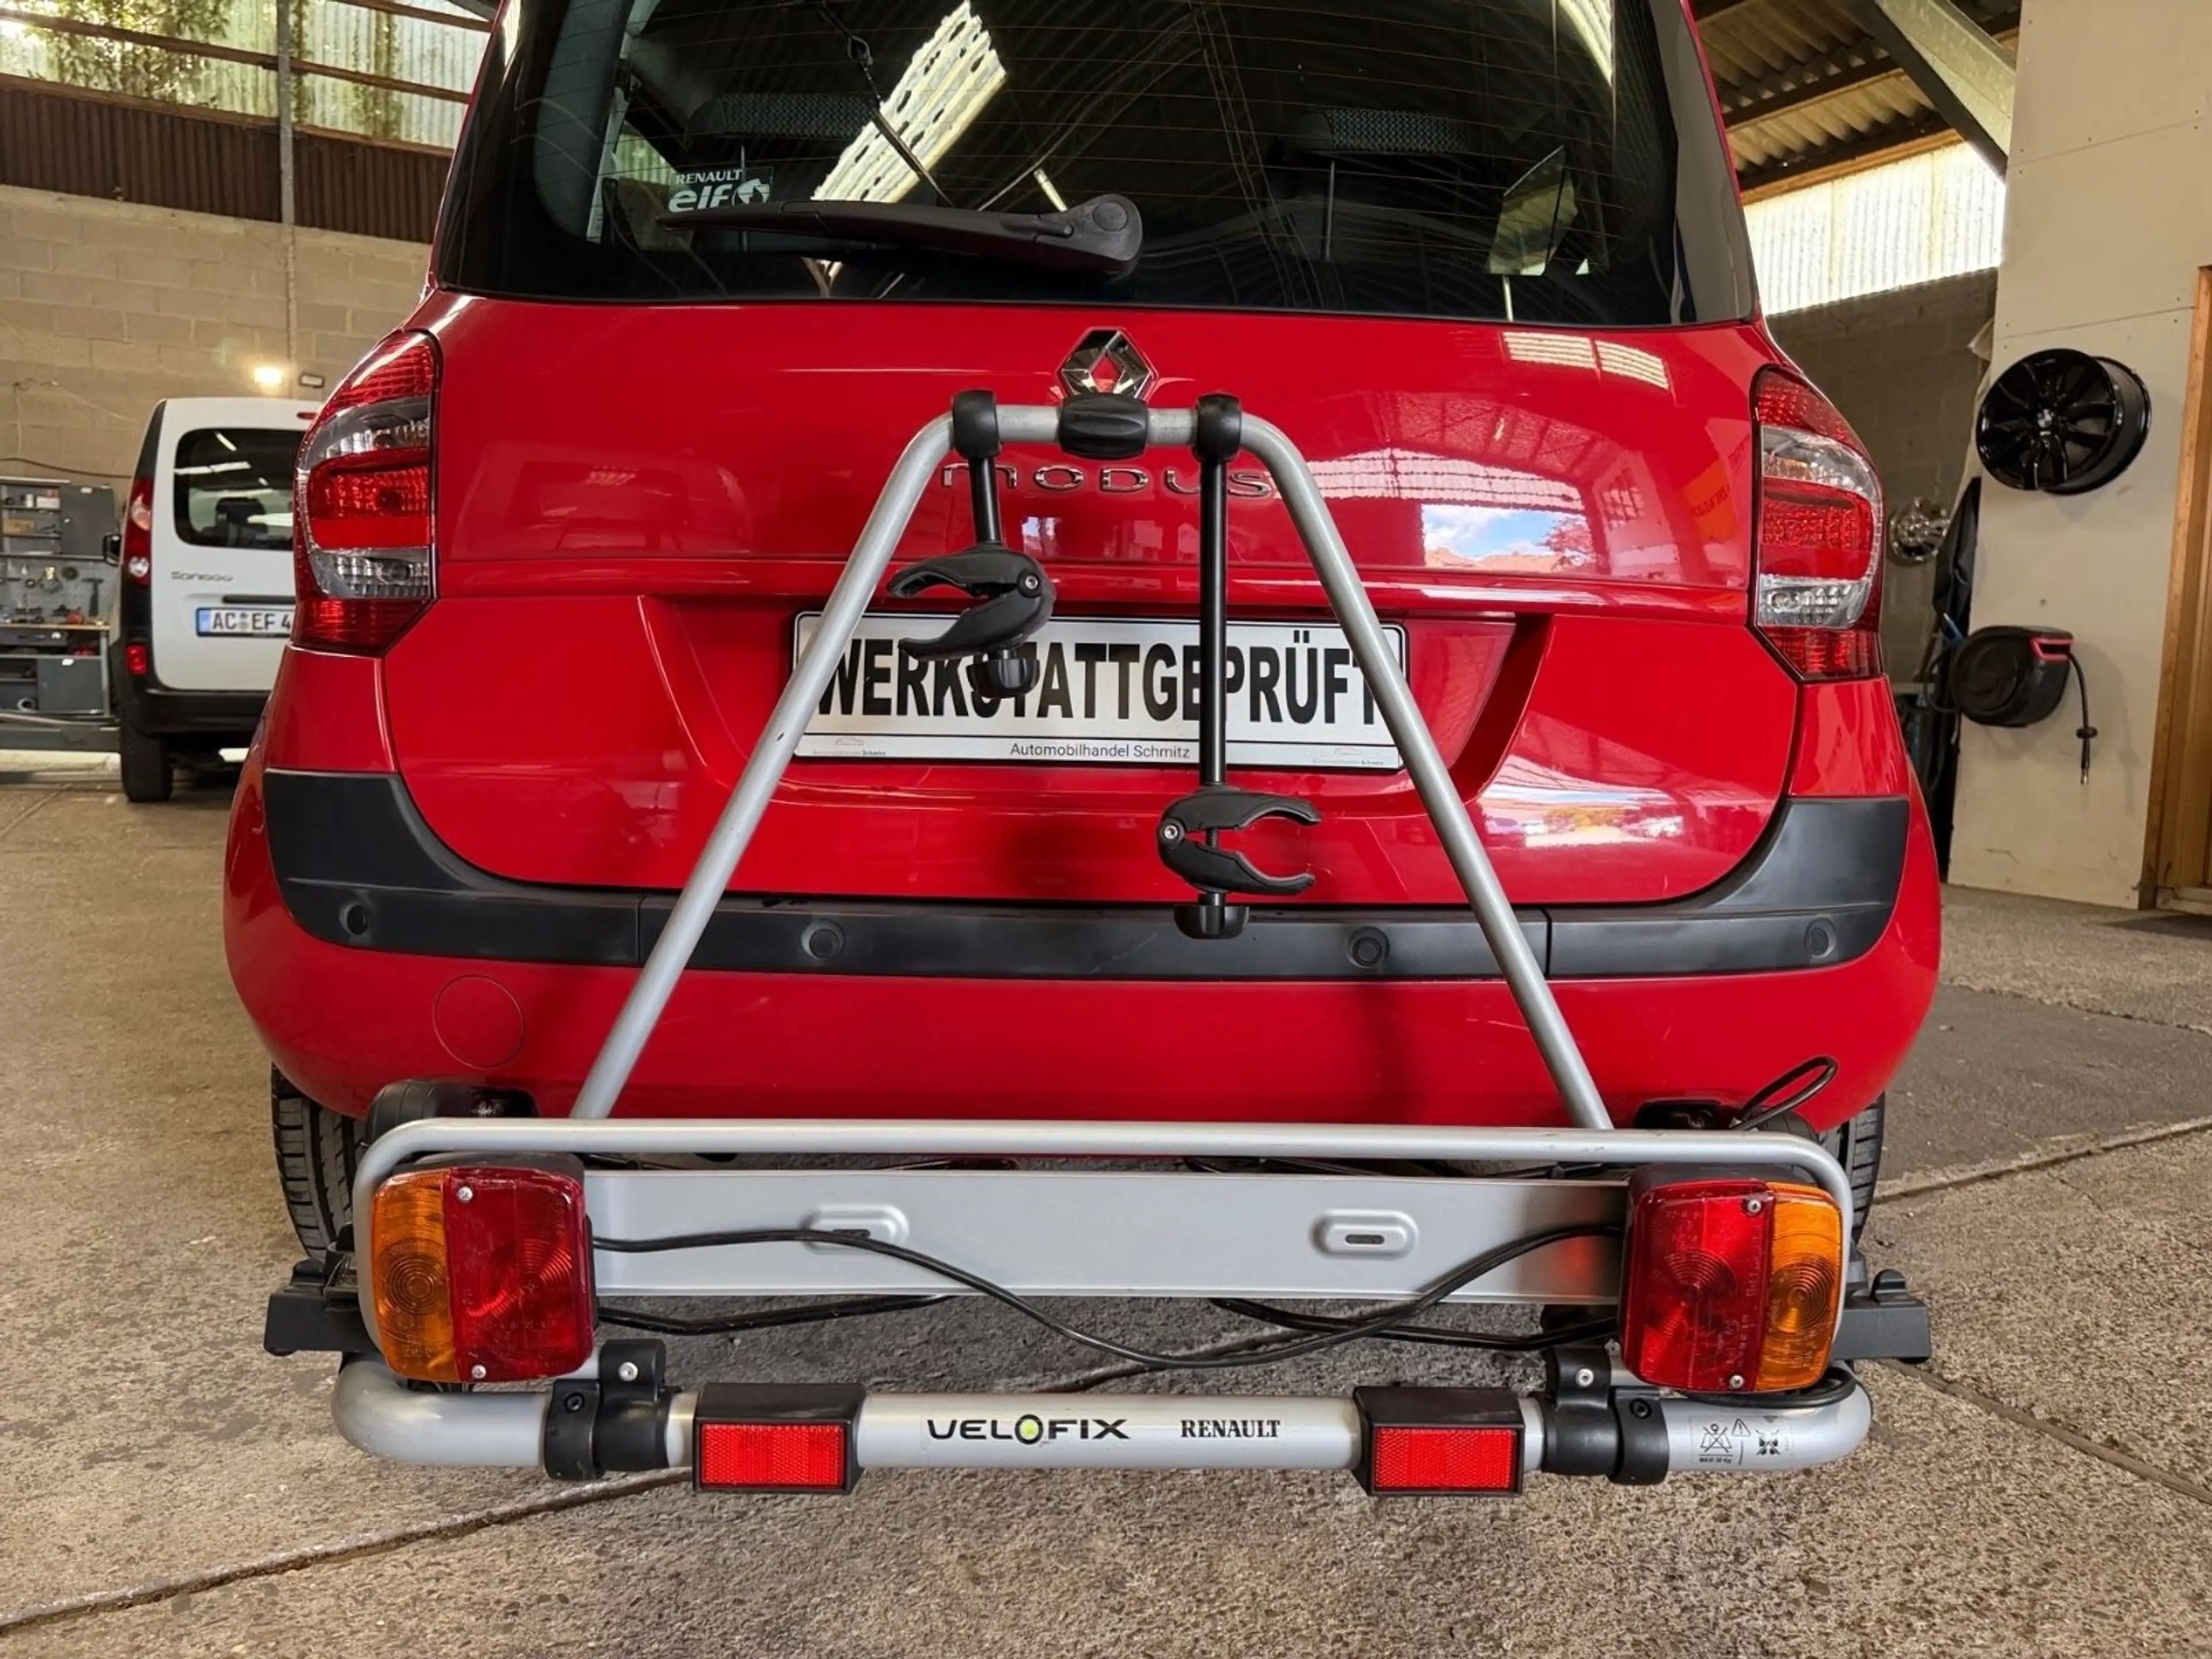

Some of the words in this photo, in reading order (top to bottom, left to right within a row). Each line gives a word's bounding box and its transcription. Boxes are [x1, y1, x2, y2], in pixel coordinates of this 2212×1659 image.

[676, 169, 743, 184] RENAULT
[669, 184, 733, 213] elf
[213, 612, 237, 630] AC
[252, 613, 275, 630] EF
[1010, 742, 1129, 757] Automobilhandel
[1133, 744, 1191, 759] Schmitz
[927, 1414, 1130, 1445] VELOFIX
[1180, 1419, 1281, 1438] RENAULT
